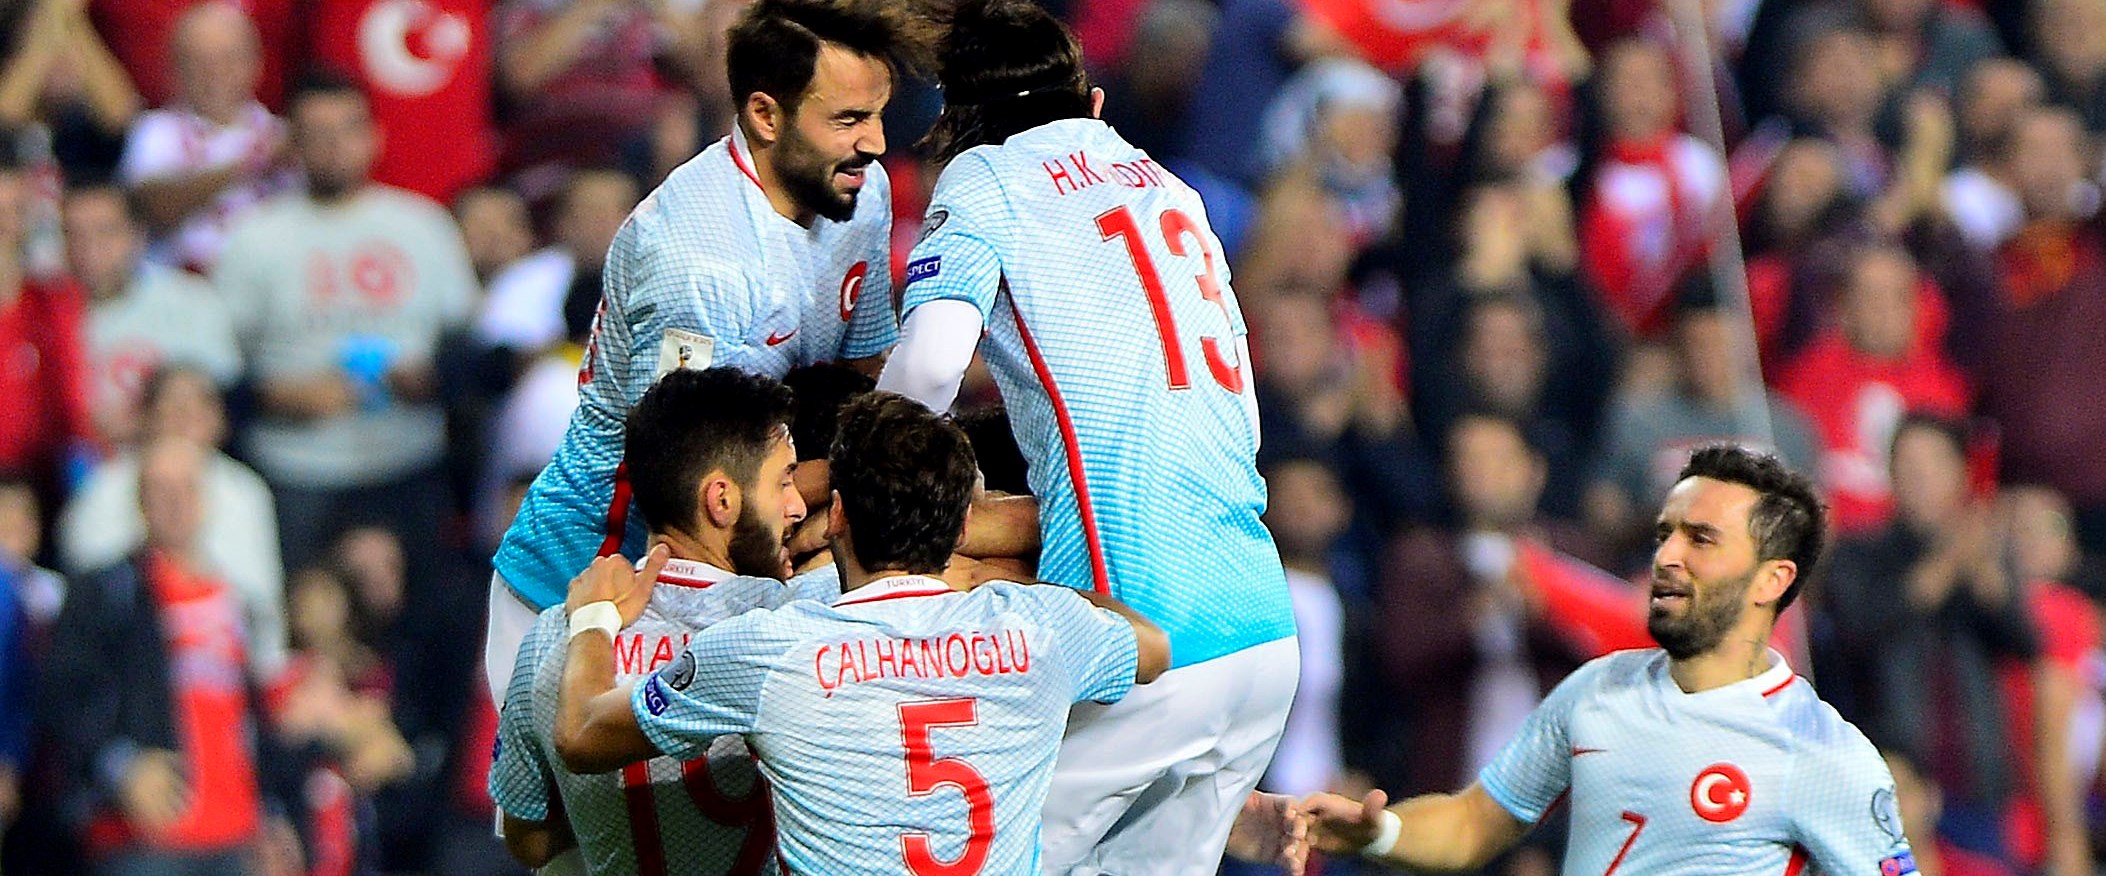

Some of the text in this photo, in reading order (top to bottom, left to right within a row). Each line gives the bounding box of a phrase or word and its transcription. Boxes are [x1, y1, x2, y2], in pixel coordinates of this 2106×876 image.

[1093, 204, 1244, 395] 13
[613, 633, 690, 675] MA
[815, 629, 1031, 699] ÇALHANOĞLU
[896, 696, 996, 876] 5
[1603, 810, 1648, 876] 7
